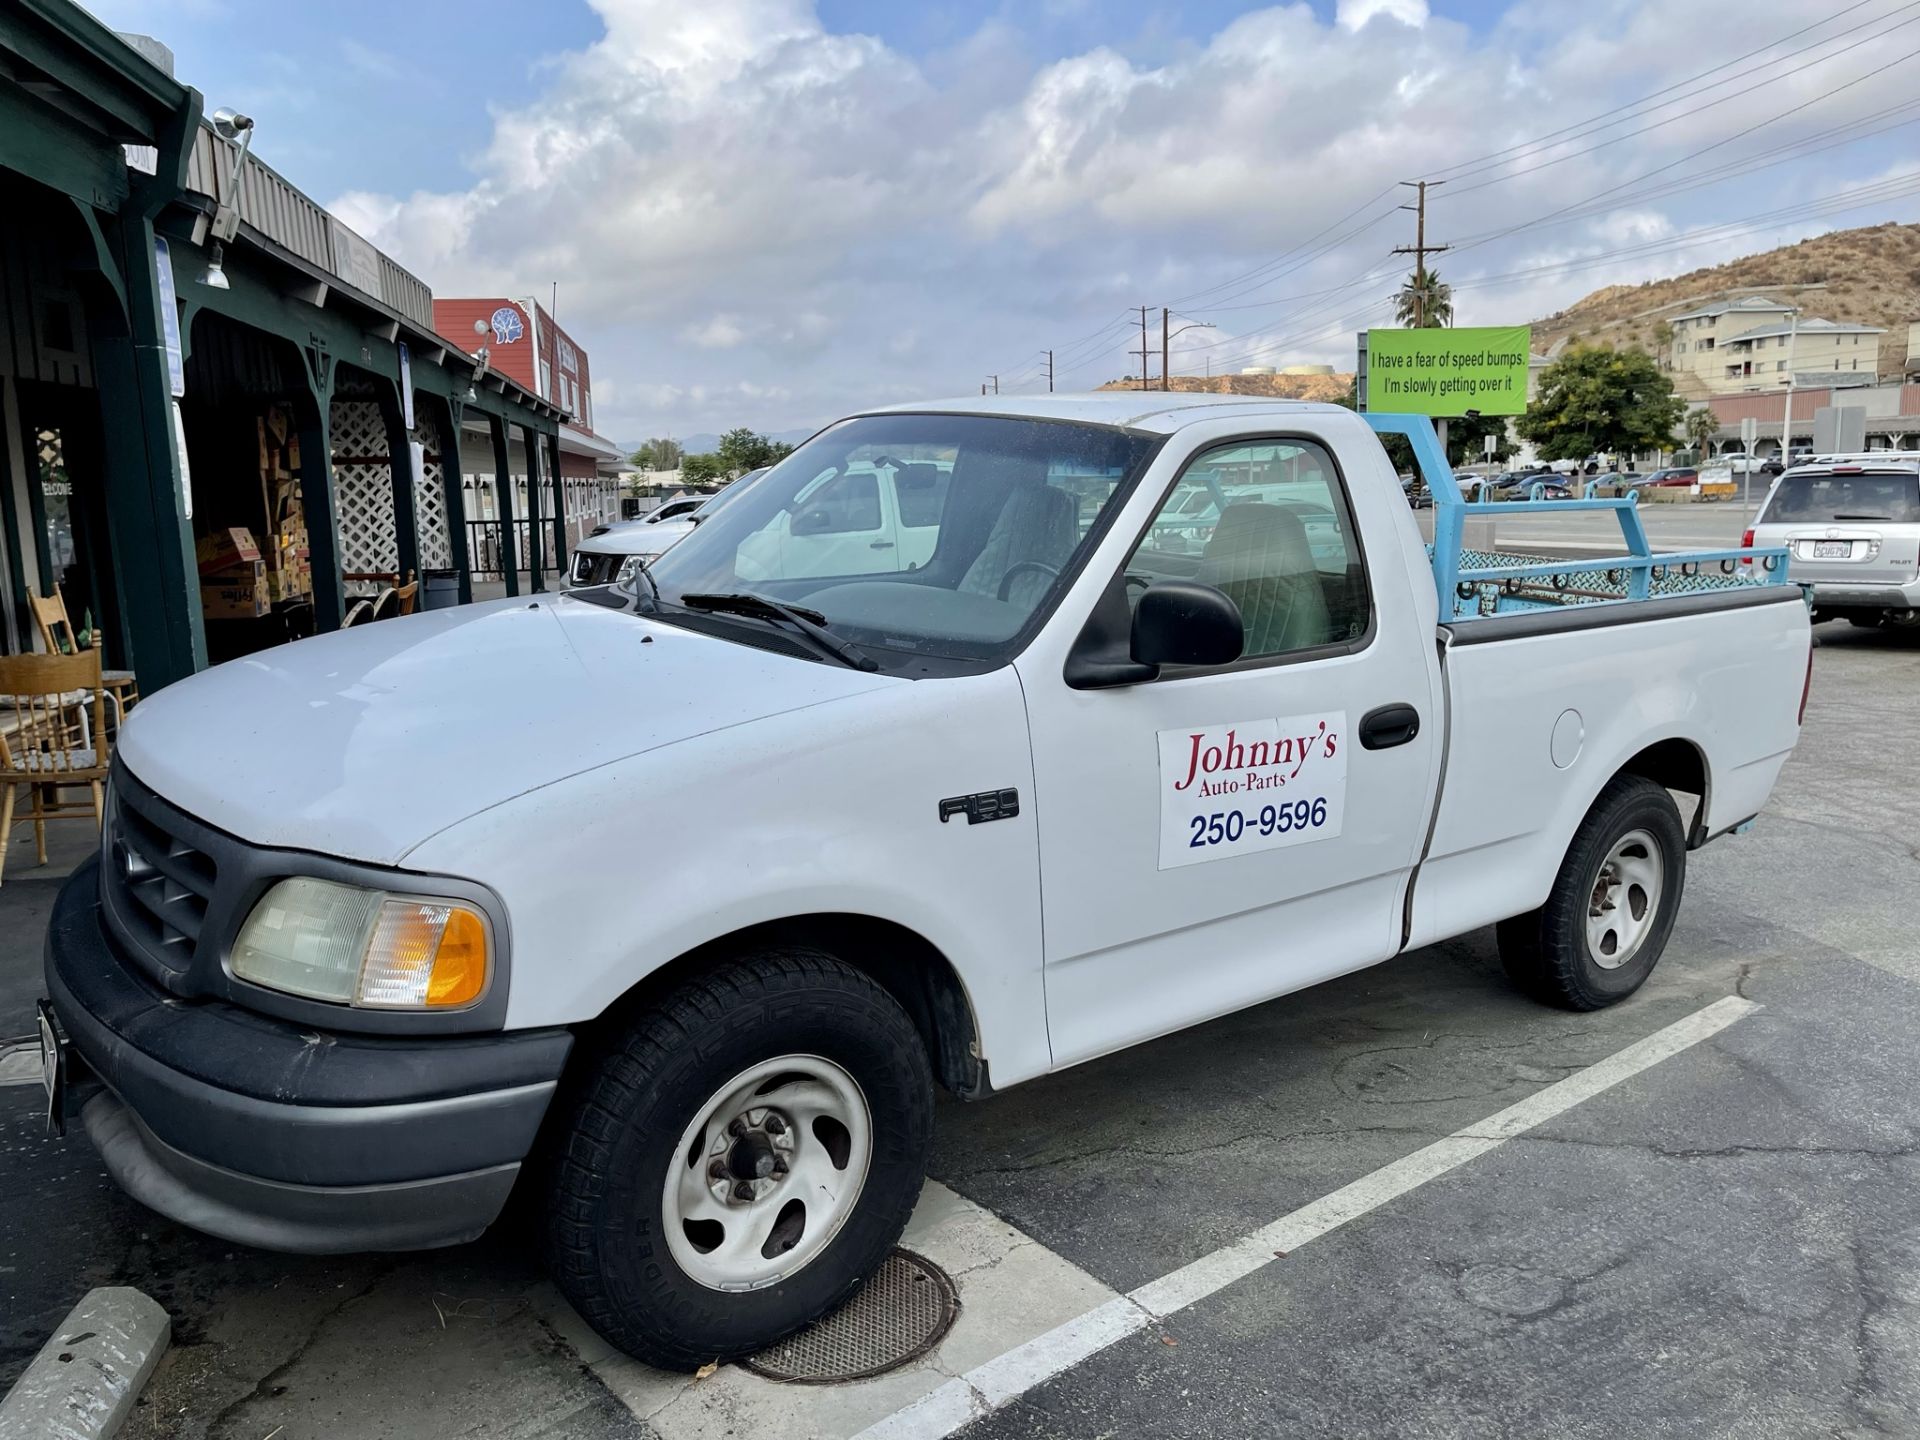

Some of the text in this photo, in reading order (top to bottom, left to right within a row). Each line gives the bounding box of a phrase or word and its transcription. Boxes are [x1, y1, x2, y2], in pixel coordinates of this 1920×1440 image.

[1378, 352, 1403, 368] have
[1406, 356, 1413, 367] a
[1416, 351, 1436, 367] fear
[1439, 351, 1450, 367] of
[1452, 351, 1484, 370] speed
[1487, 350, 1525, 369] bumps.
[1384, 375, 1512, 397] I'm slowly getting over it
[1175, 721, 1337, 791] Johnny's
[1198, 772, 1286, 797] Auto-Parts
[1189, 797, 1327, 848] 250-9596
